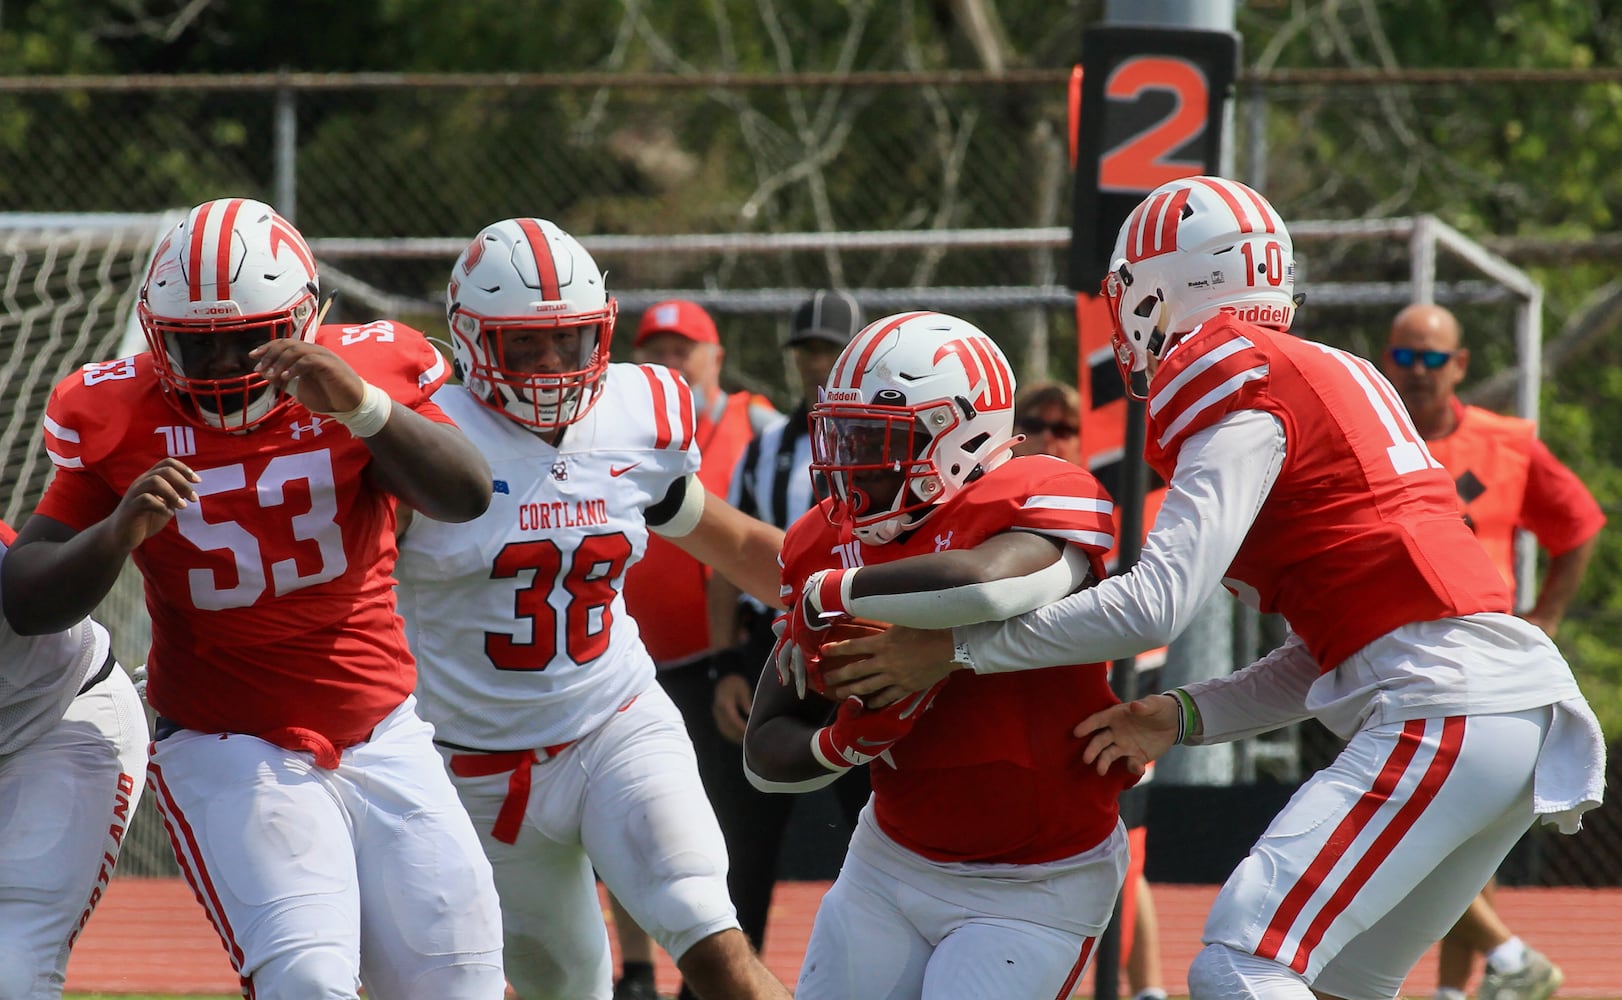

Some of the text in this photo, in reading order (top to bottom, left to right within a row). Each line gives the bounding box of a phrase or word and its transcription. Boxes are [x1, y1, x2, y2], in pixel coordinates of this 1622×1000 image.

[1098, 56, 1209, 192] 2
[1241, 241, 1282, 286] 10
[536, 304, 567, 312] CORTLAND
[83, 357, 136, 386] 53
[827, 391, 858, 401] Riddell
[174, 448, 348, 611] 53
[519, 498, 608, 531] CORTLAND
[485, 532, 632, 671] 38
